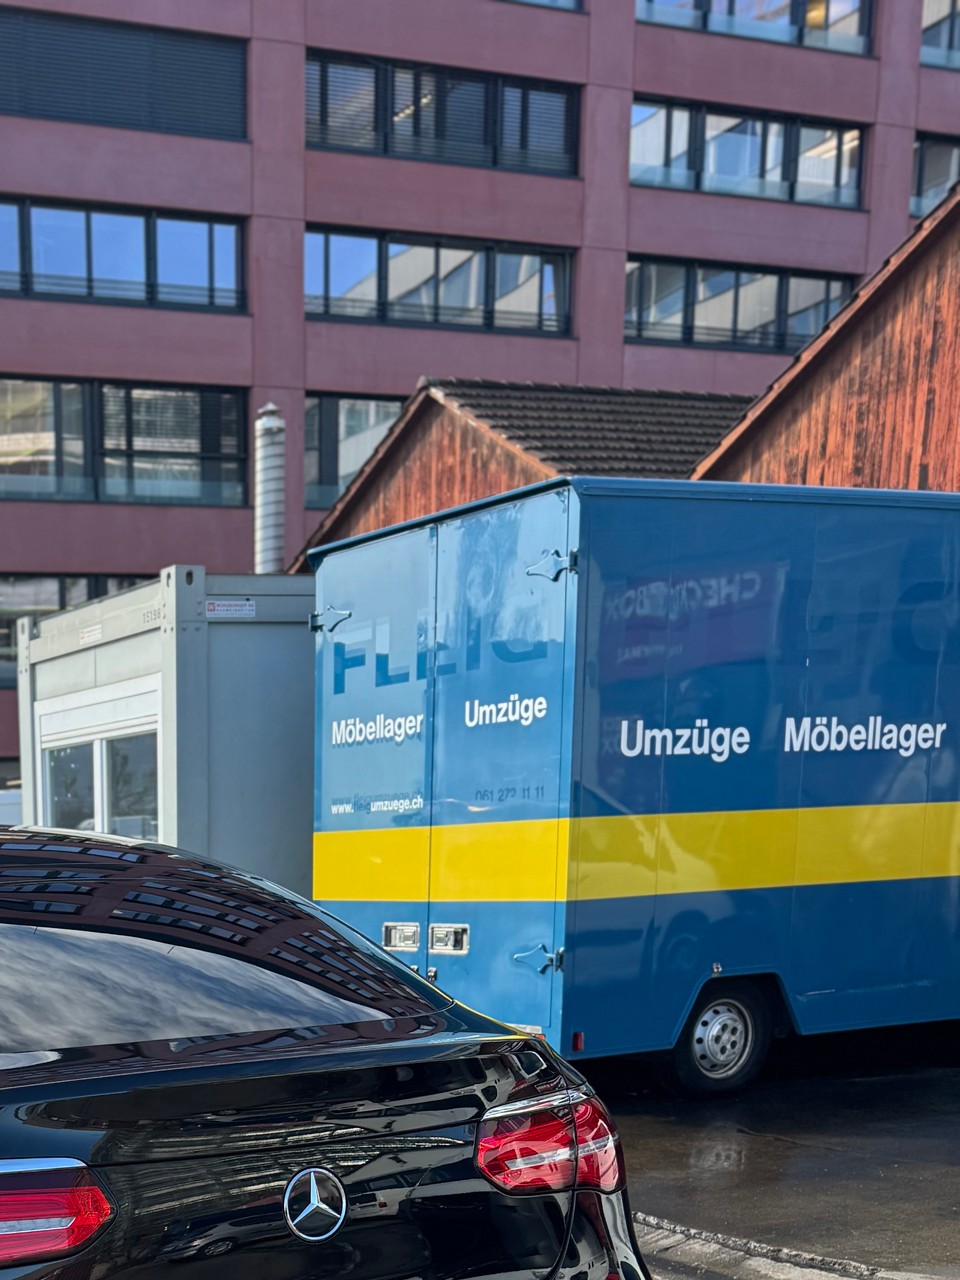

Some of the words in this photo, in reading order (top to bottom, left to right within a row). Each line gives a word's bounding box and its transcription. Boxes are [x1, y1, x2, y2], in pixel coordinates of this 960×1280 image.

[464, 693, 548, 728] Umzüge
[331, 713, 424, 745] Möbellager
[620, 718, 751, 763] Umzüge
[783, 715, 947, 758] Möbellager
